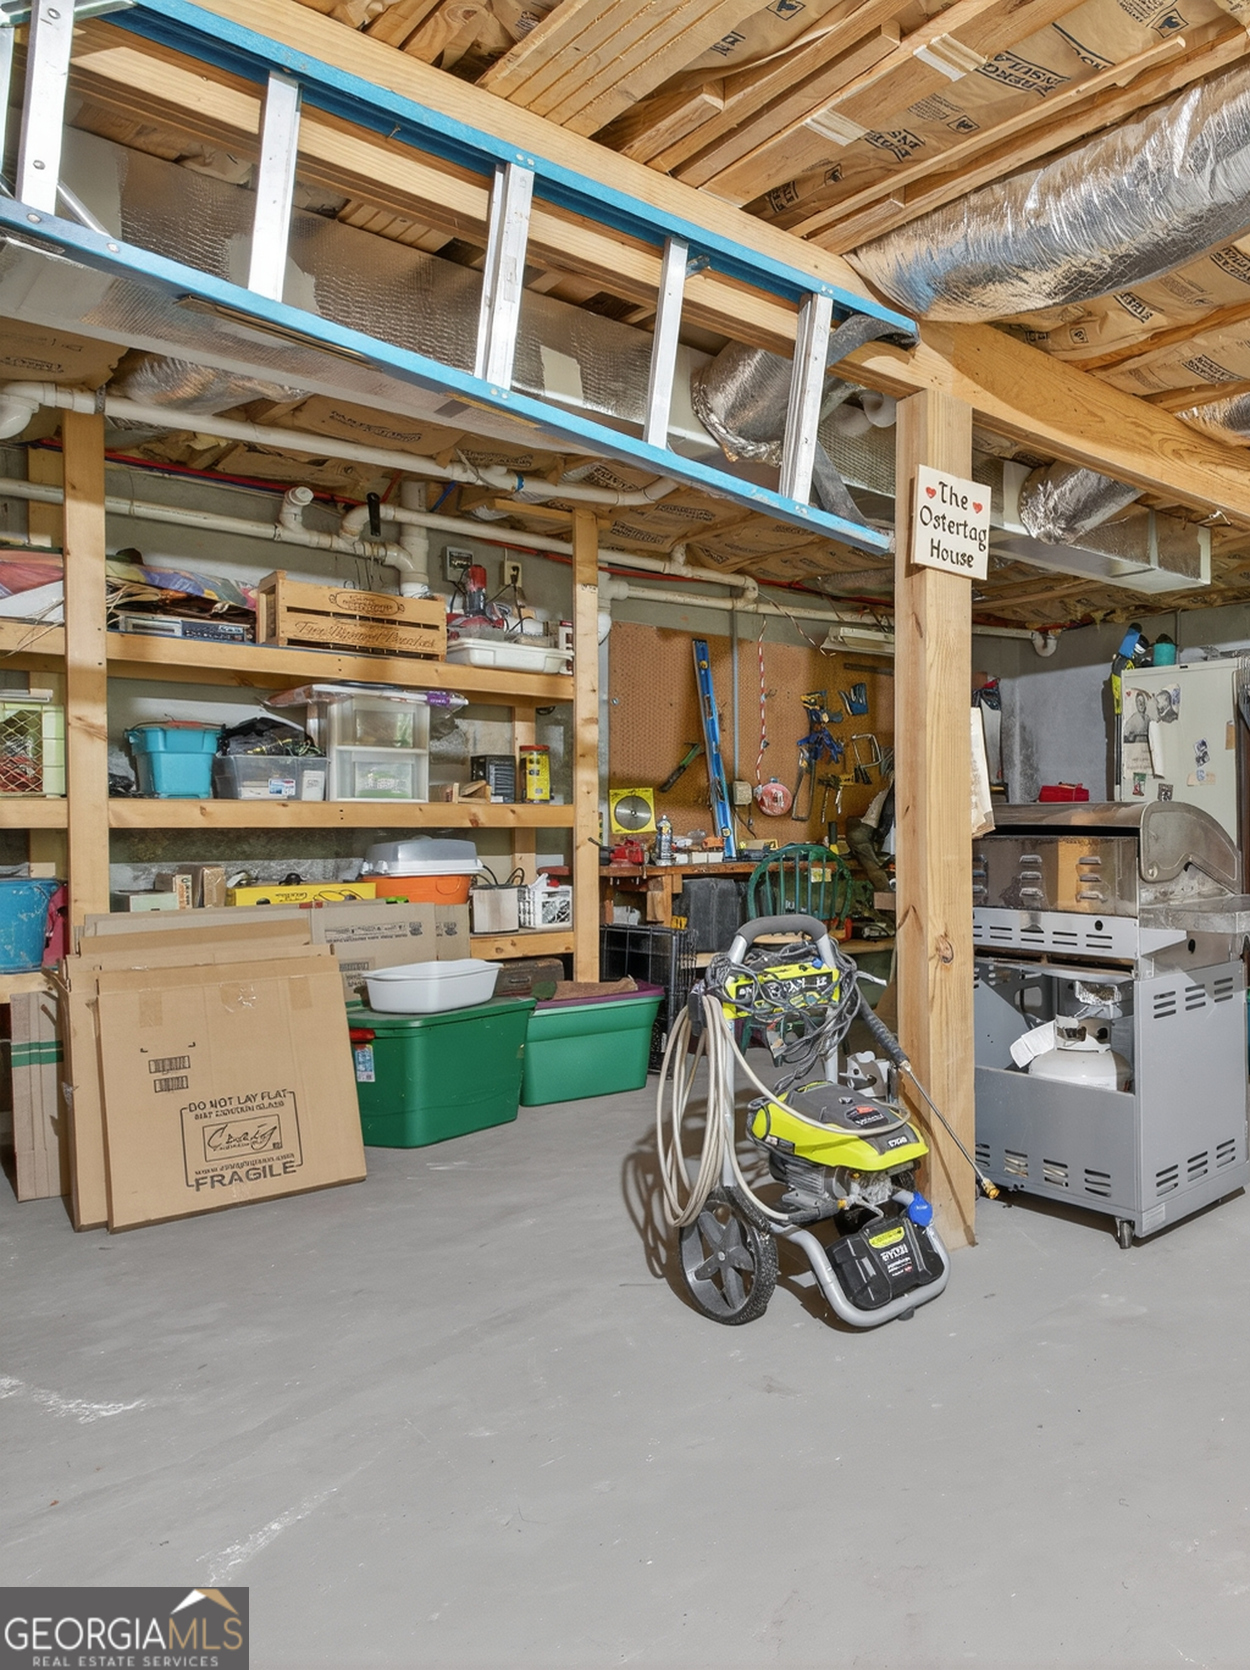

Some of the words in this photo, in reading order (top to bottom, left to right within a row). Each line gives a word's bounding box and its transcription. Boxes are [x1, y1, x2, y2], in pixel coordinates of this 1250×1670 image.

[938, 481, 968, 510] The
[919, 504, 987, 552] Ostertag
[930, 538, 974, 569] House
[188, 1101, 207, 1112] DO
[209, 1097, 234, 1110] NOT
[237, 1093, 259, 1105] LAY
[260, 1089, 288, 1101] FLAT
[194, 1160, 297, 1192] FRAGILE
